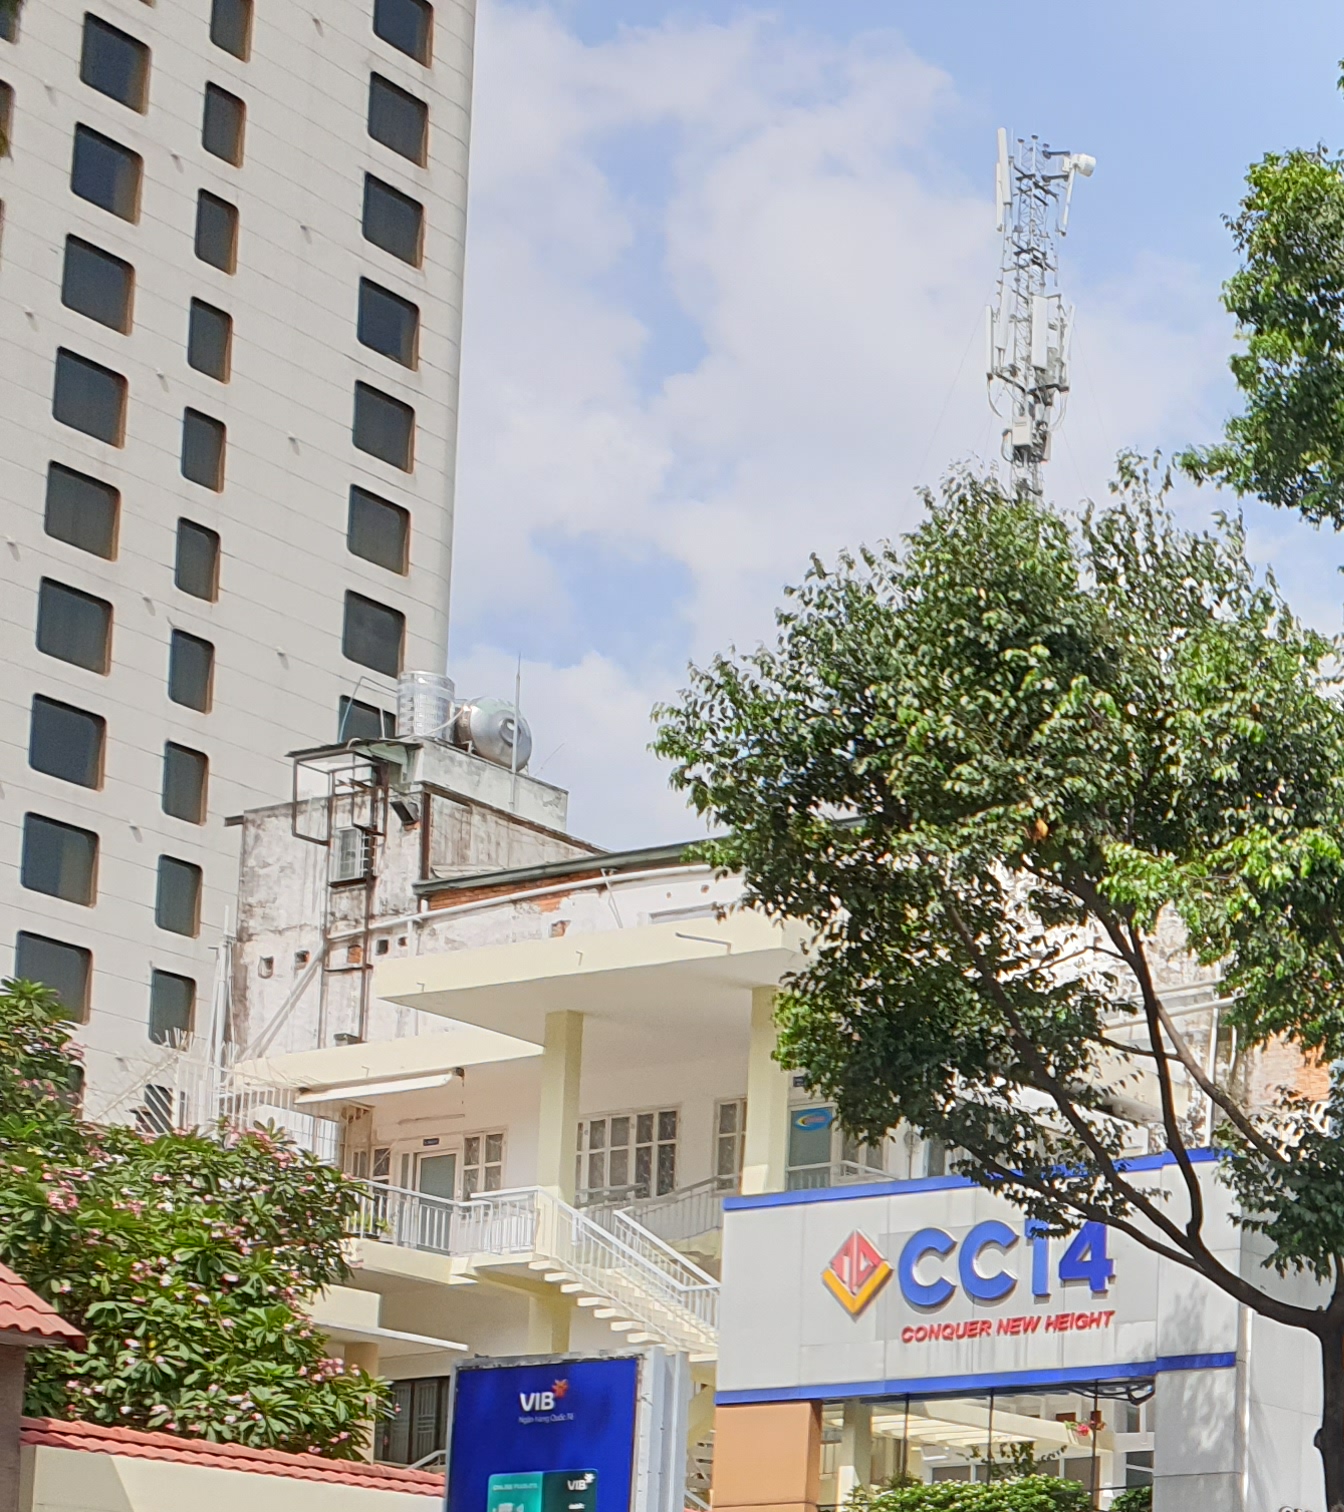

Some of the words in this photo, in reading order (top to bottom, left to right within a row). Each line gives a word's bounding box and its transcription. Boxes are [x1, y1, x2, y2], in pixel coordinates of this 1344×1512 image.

[901, 1320, 991, 1344] CONQUER
[996, 1315, 1041, 1335] NEW
[1045, 1310, 1116, 1333] HEIGHT
[519, 1390, 556, 1412] VIB
[567, 1480, 588, 1491] VIB
